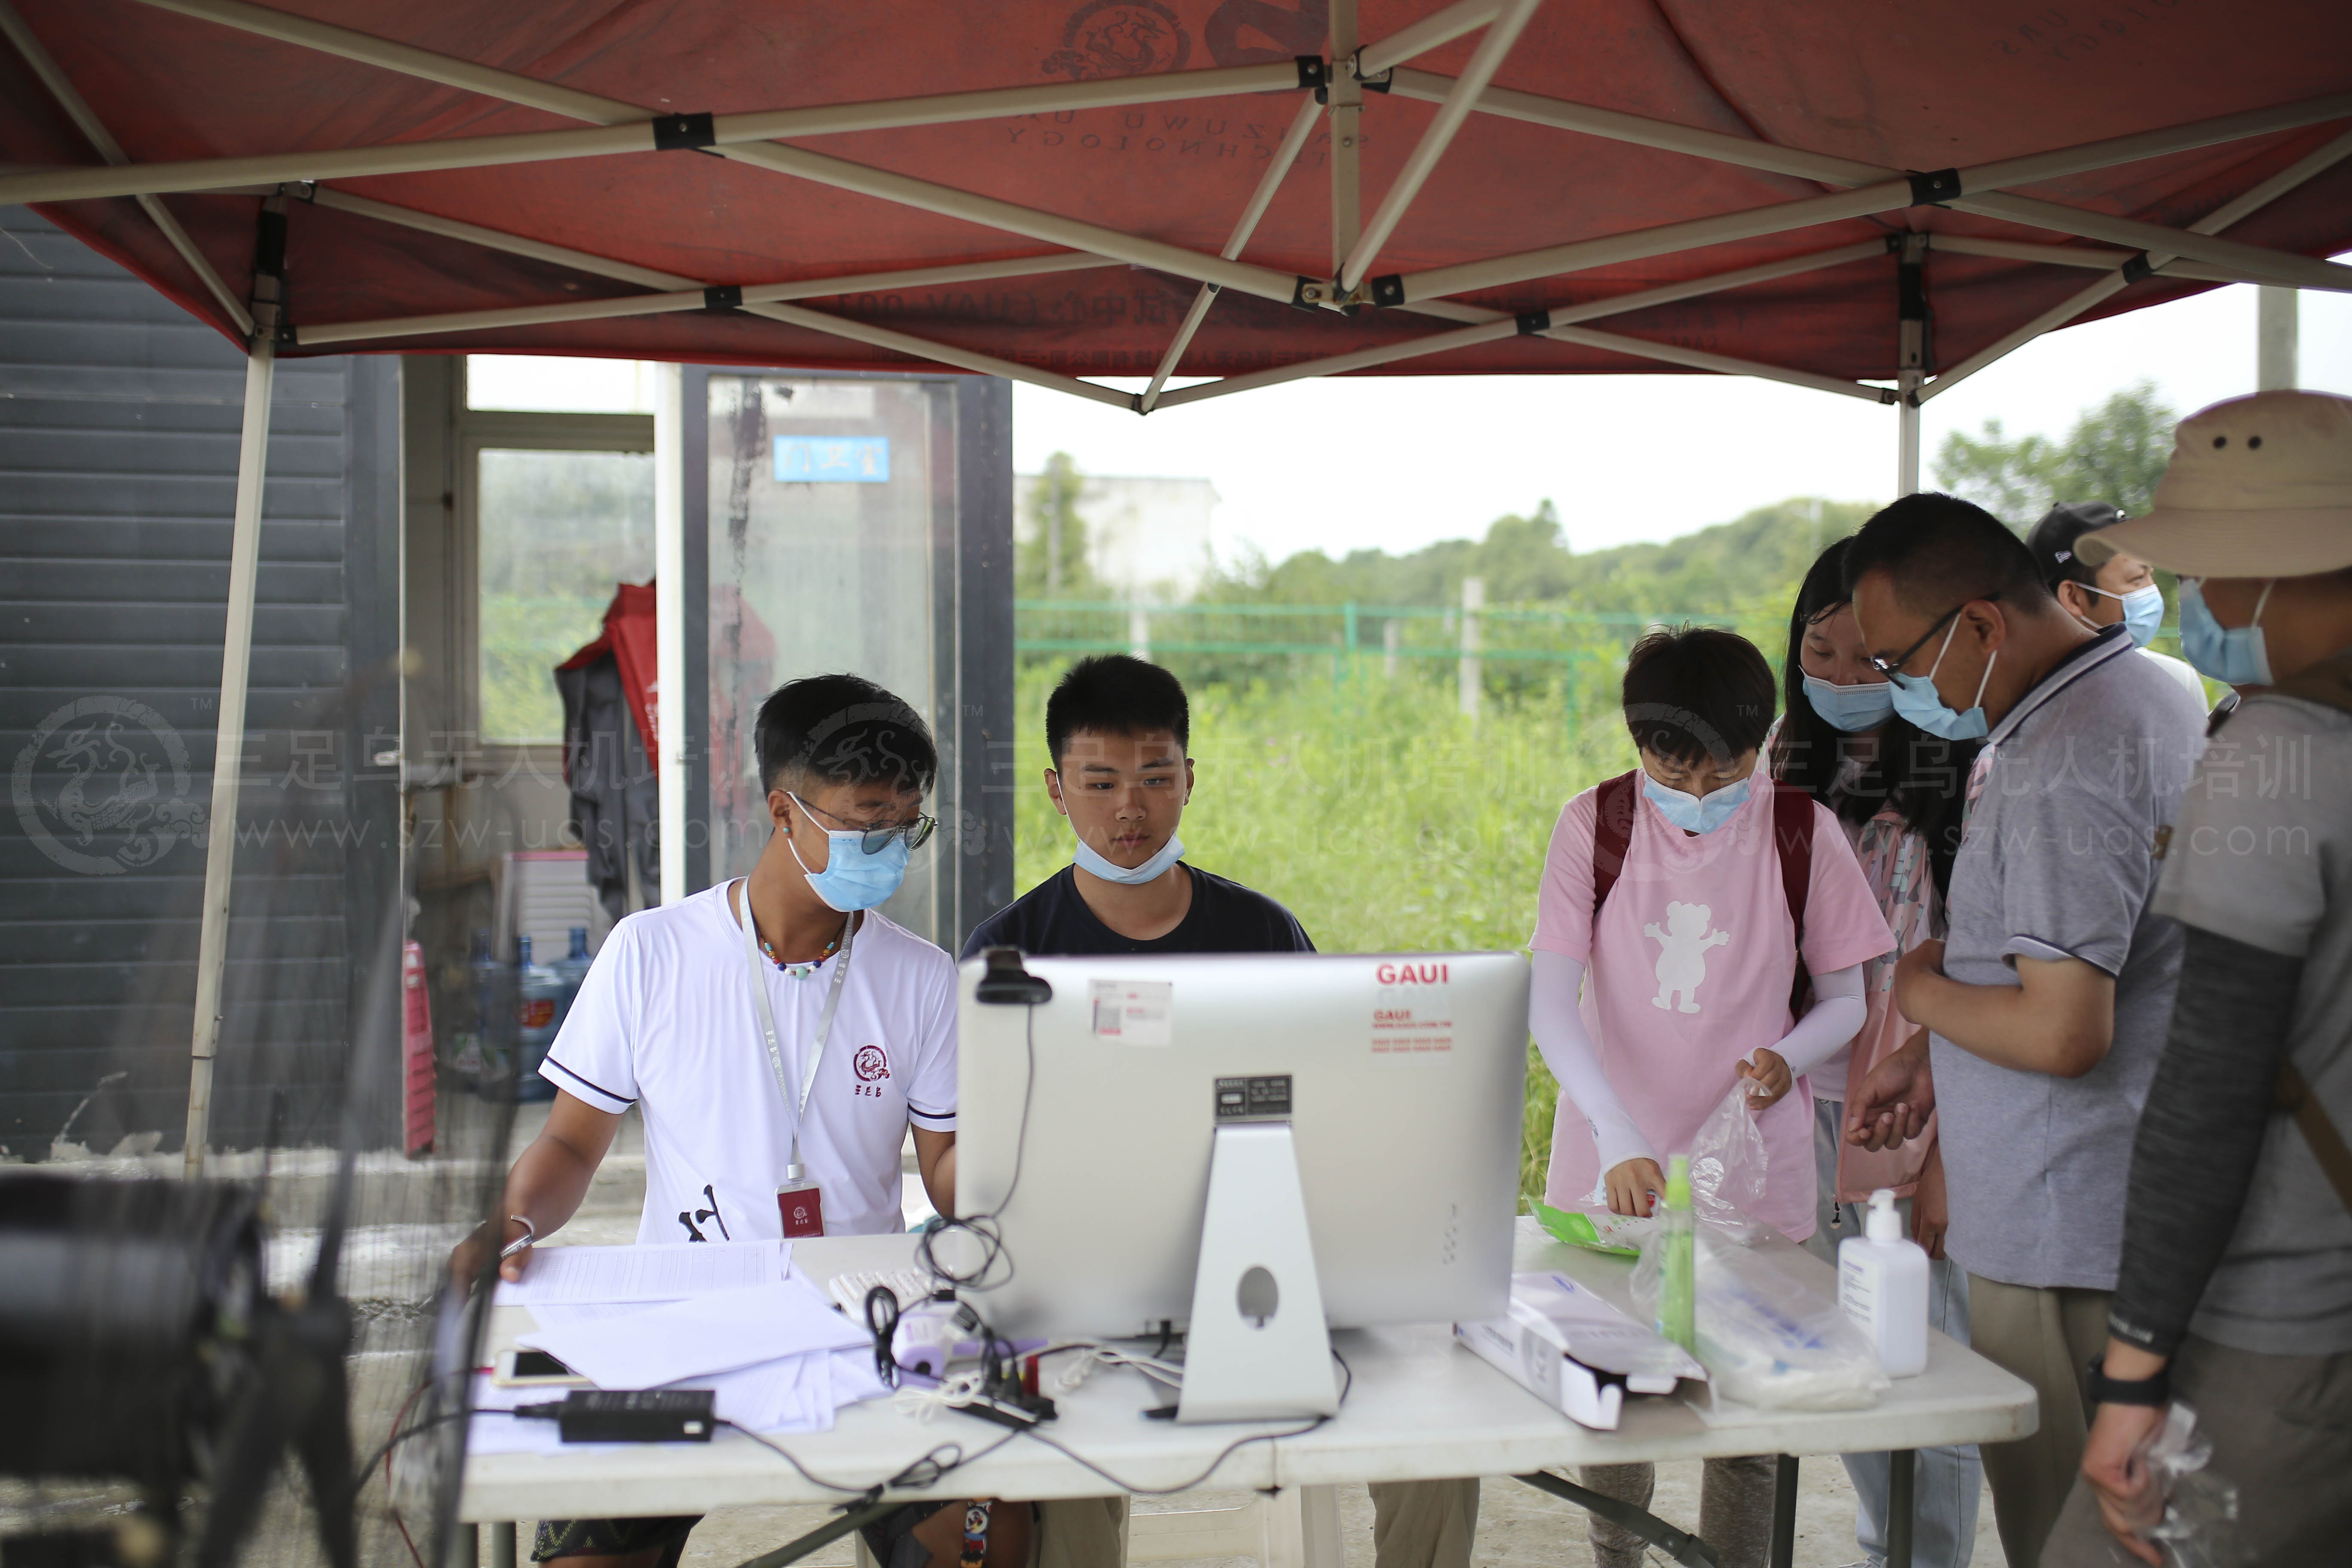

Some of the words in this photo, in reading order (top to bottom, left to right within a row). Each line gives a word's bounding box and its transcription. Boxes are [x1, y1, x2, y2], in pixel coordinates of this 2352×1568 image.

[786, 443, 883, 476] 门卫室
[1377, 964, 1448, 985] GAUI
[1373, 1009, 1411, 1021] GAUI
